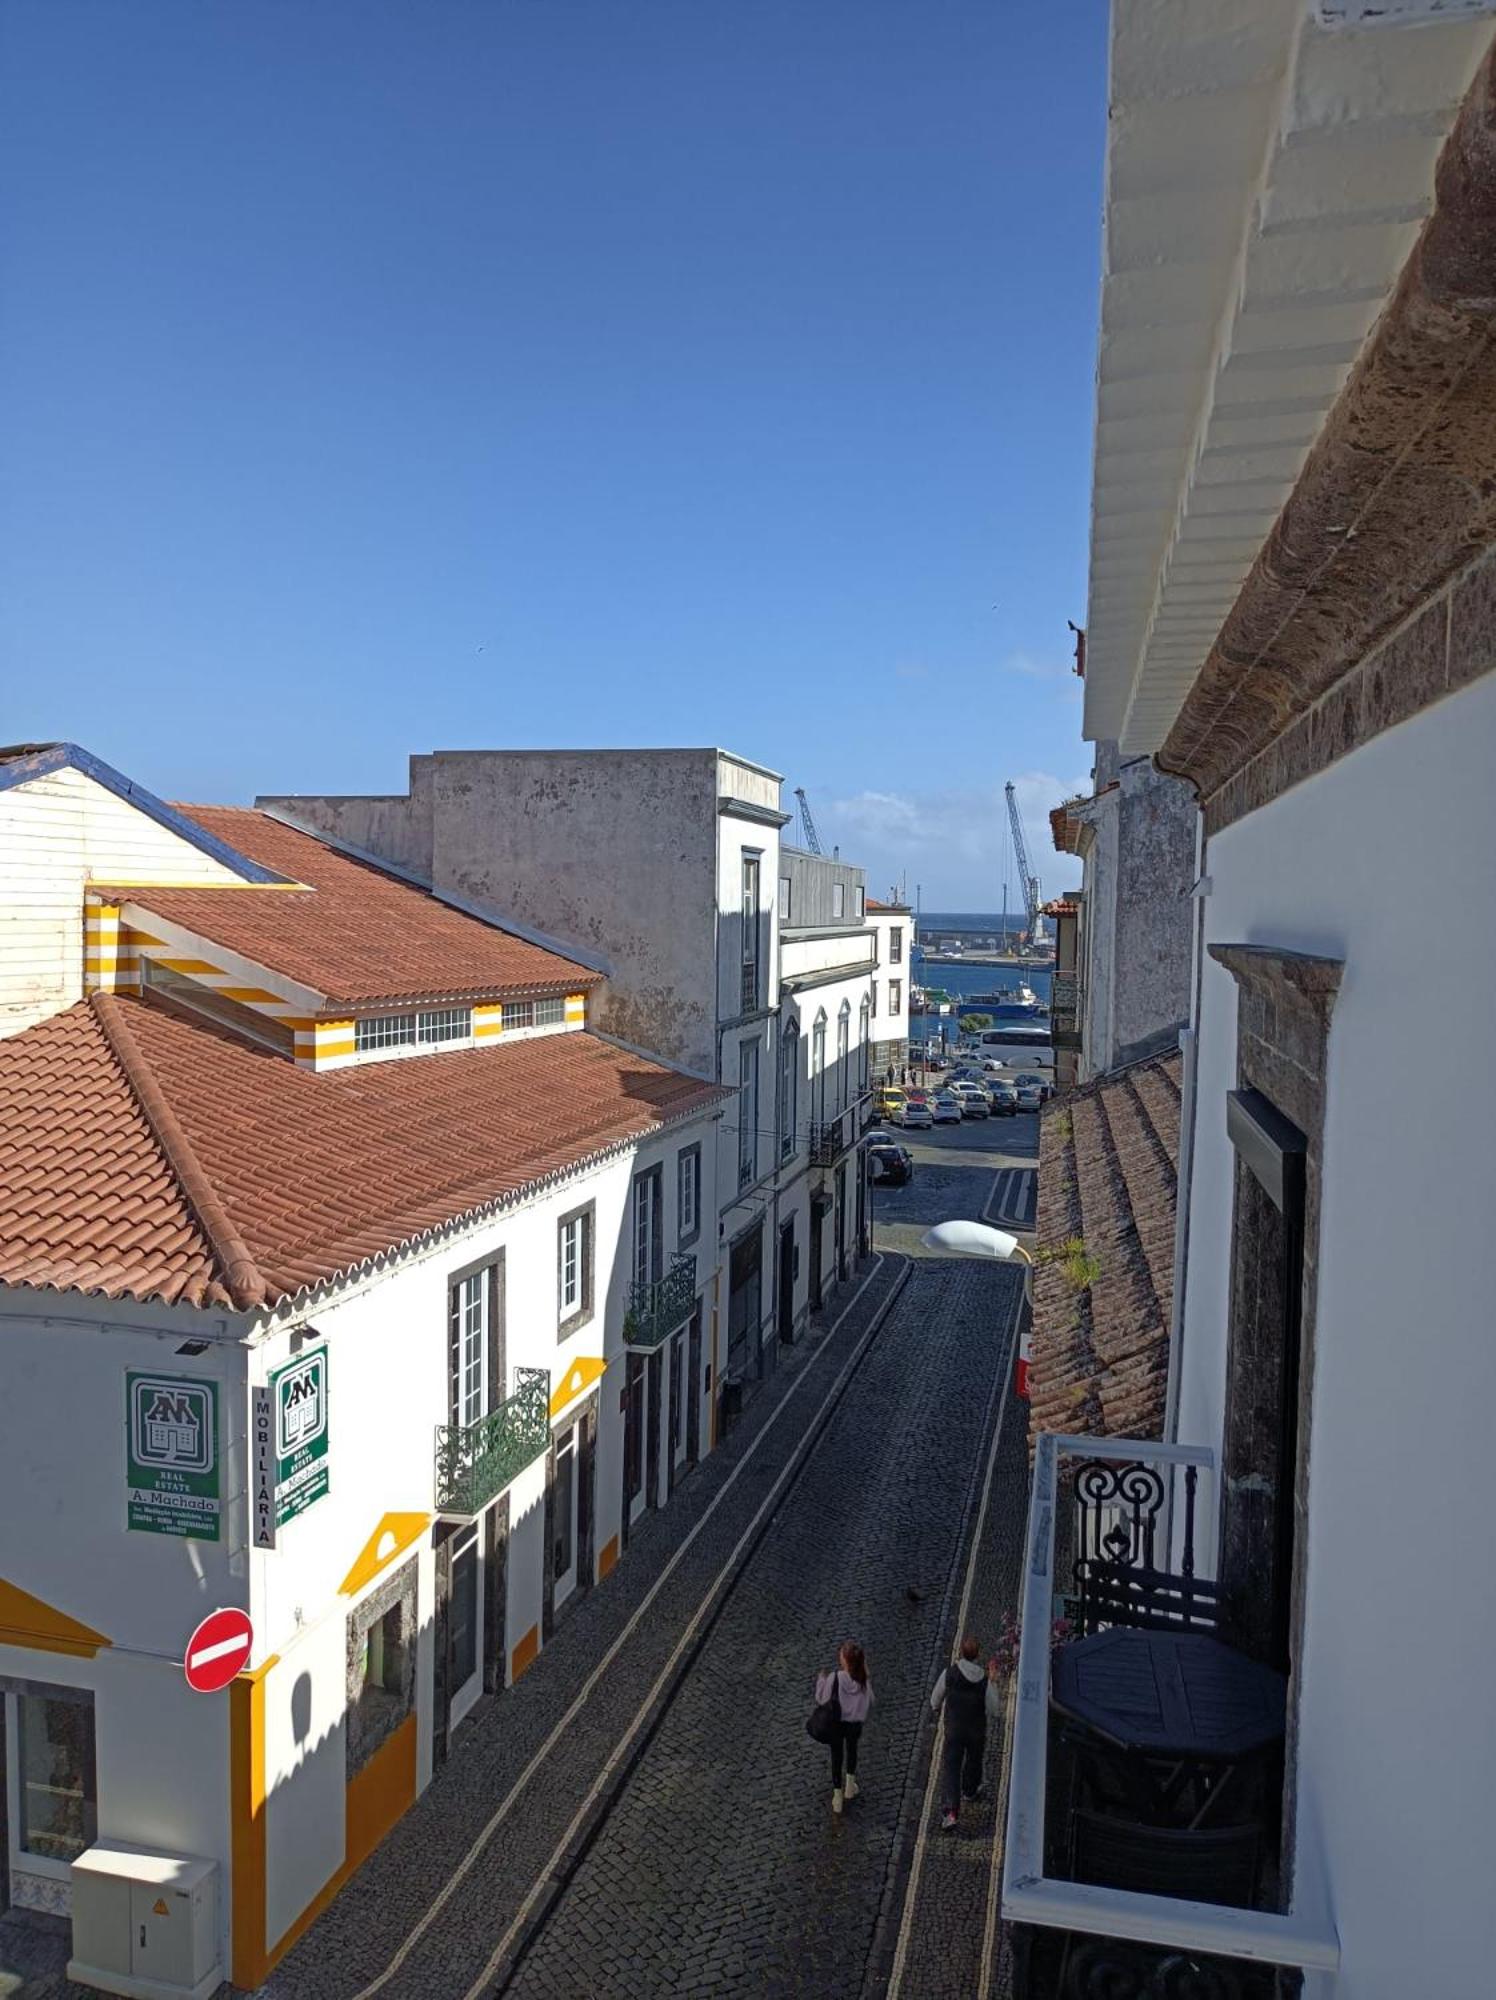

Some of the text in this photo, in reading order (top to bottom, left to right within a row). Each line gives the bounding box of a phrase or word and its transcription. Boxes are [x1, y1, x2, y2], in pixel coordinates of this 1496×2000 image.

[160, 1471, 185, 1482] REAL
[155, 1480, 191, 1492] ESTATE
[132, 1490, 214, 1510] A. Machado
